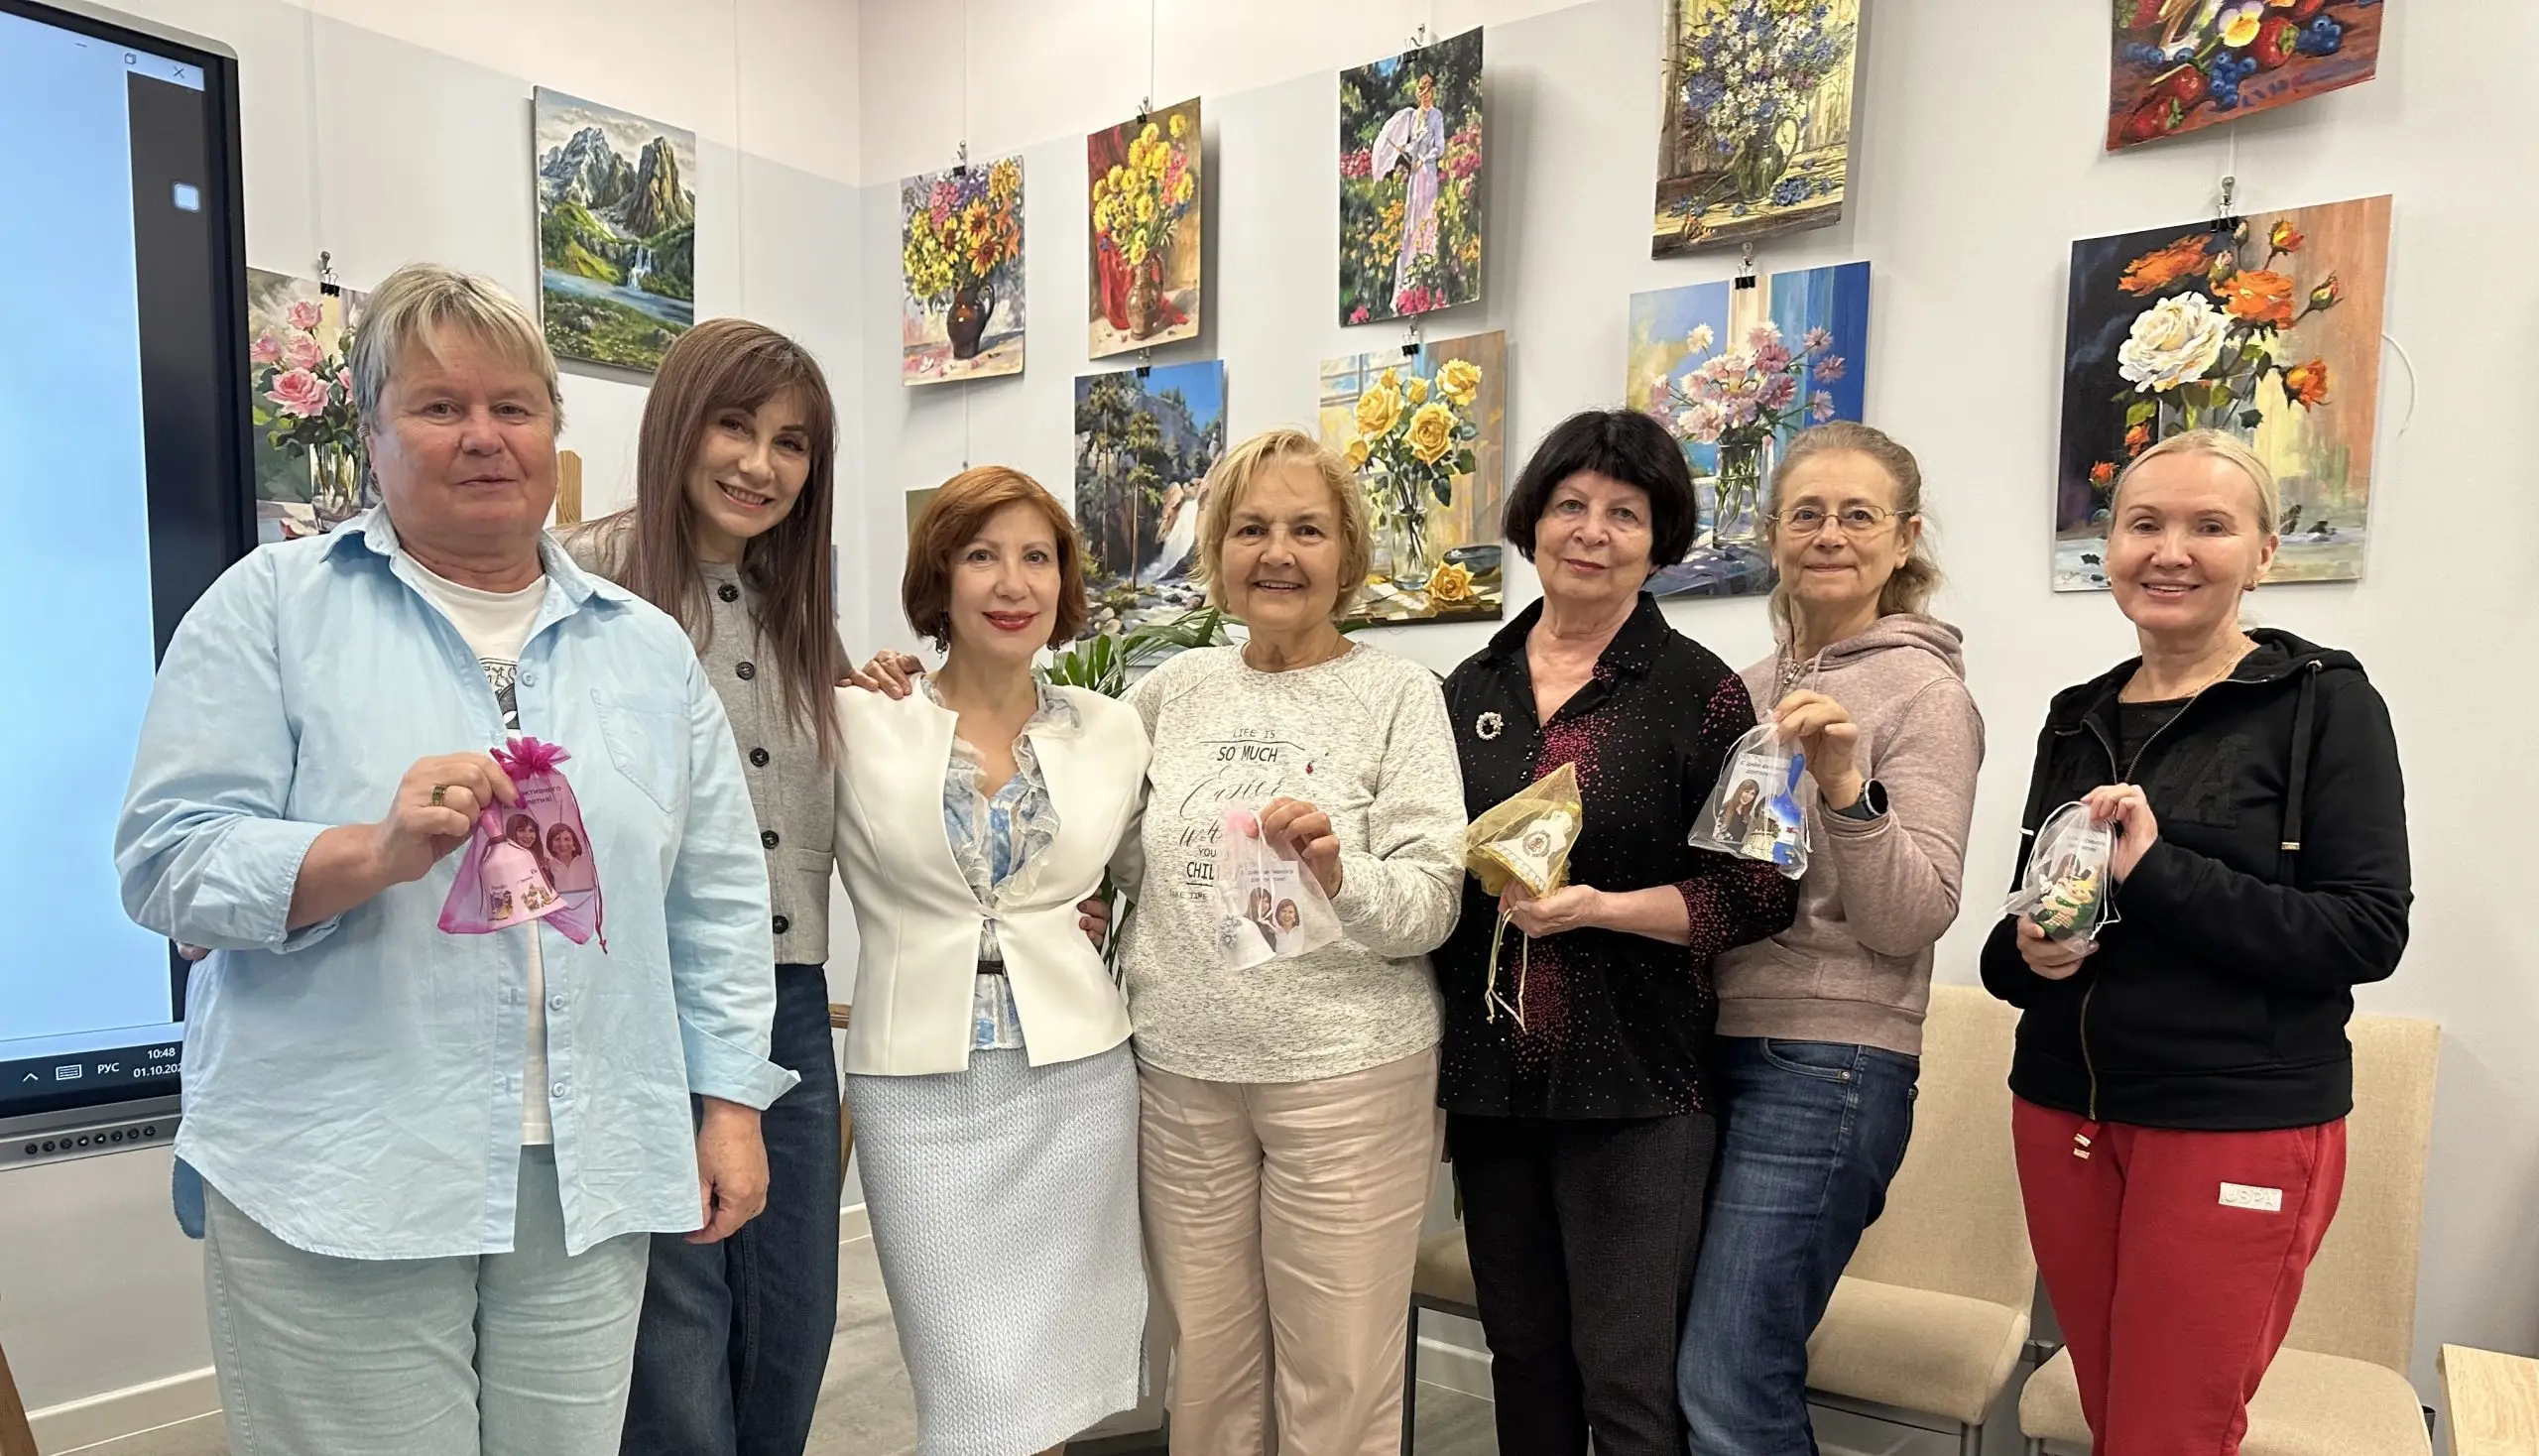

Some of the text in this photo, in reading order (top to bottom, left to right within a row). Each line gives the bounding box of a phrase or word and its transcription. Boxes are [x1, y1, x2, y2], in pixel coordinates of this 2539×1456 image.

[1233, 728, 1276, 739] LIFE IS
[1217, 745, 1278, 763] SO MUCH
[523, 786, 561, 796] ктивного
[1198, 848, 1217, 858] YOU
[1186, 861, 1215, 881] CHIL
[147, 1047, 177, 1060] 10:48
[97, 1062, 120, 1074] РУС
[133, 1062, 181, 1078] 01.10.202
